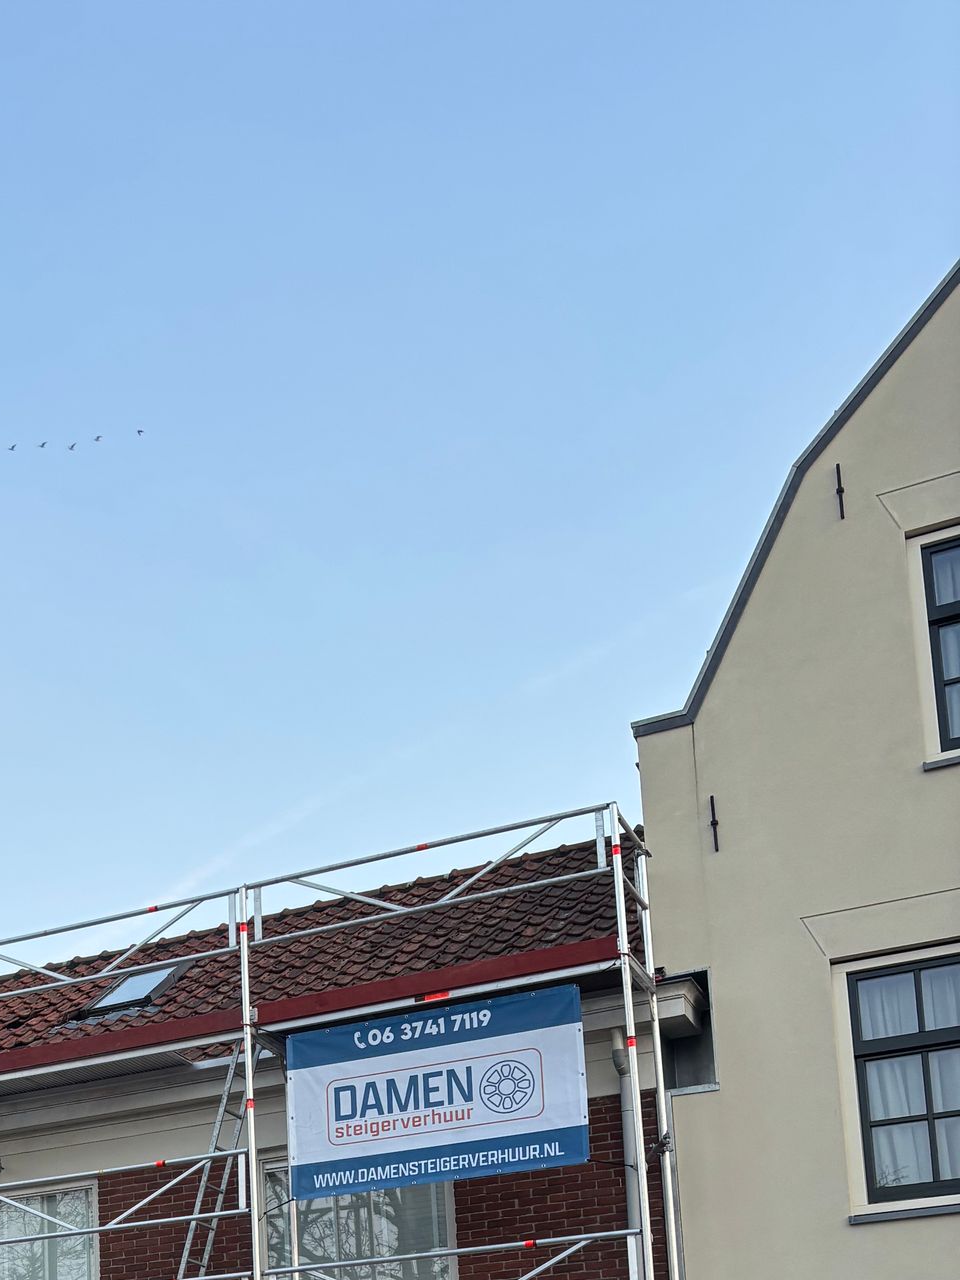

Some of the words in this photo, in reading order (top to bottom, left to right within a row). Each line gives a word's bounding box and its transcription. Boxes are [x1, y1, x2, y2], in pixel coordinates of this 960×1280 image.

[368, 1025, 394, 1047] 06
[400, 1017, 446, 1040] 3741
[451, 1009, 492, 1032] 7119
[333, 1065, 474, 1122] DAMEN
[334, 1107, 474, 1139] steigerverhuur
[313, 1141, 565, 1189] WWW.DAMENSTEIGERVERHUUR.NL
